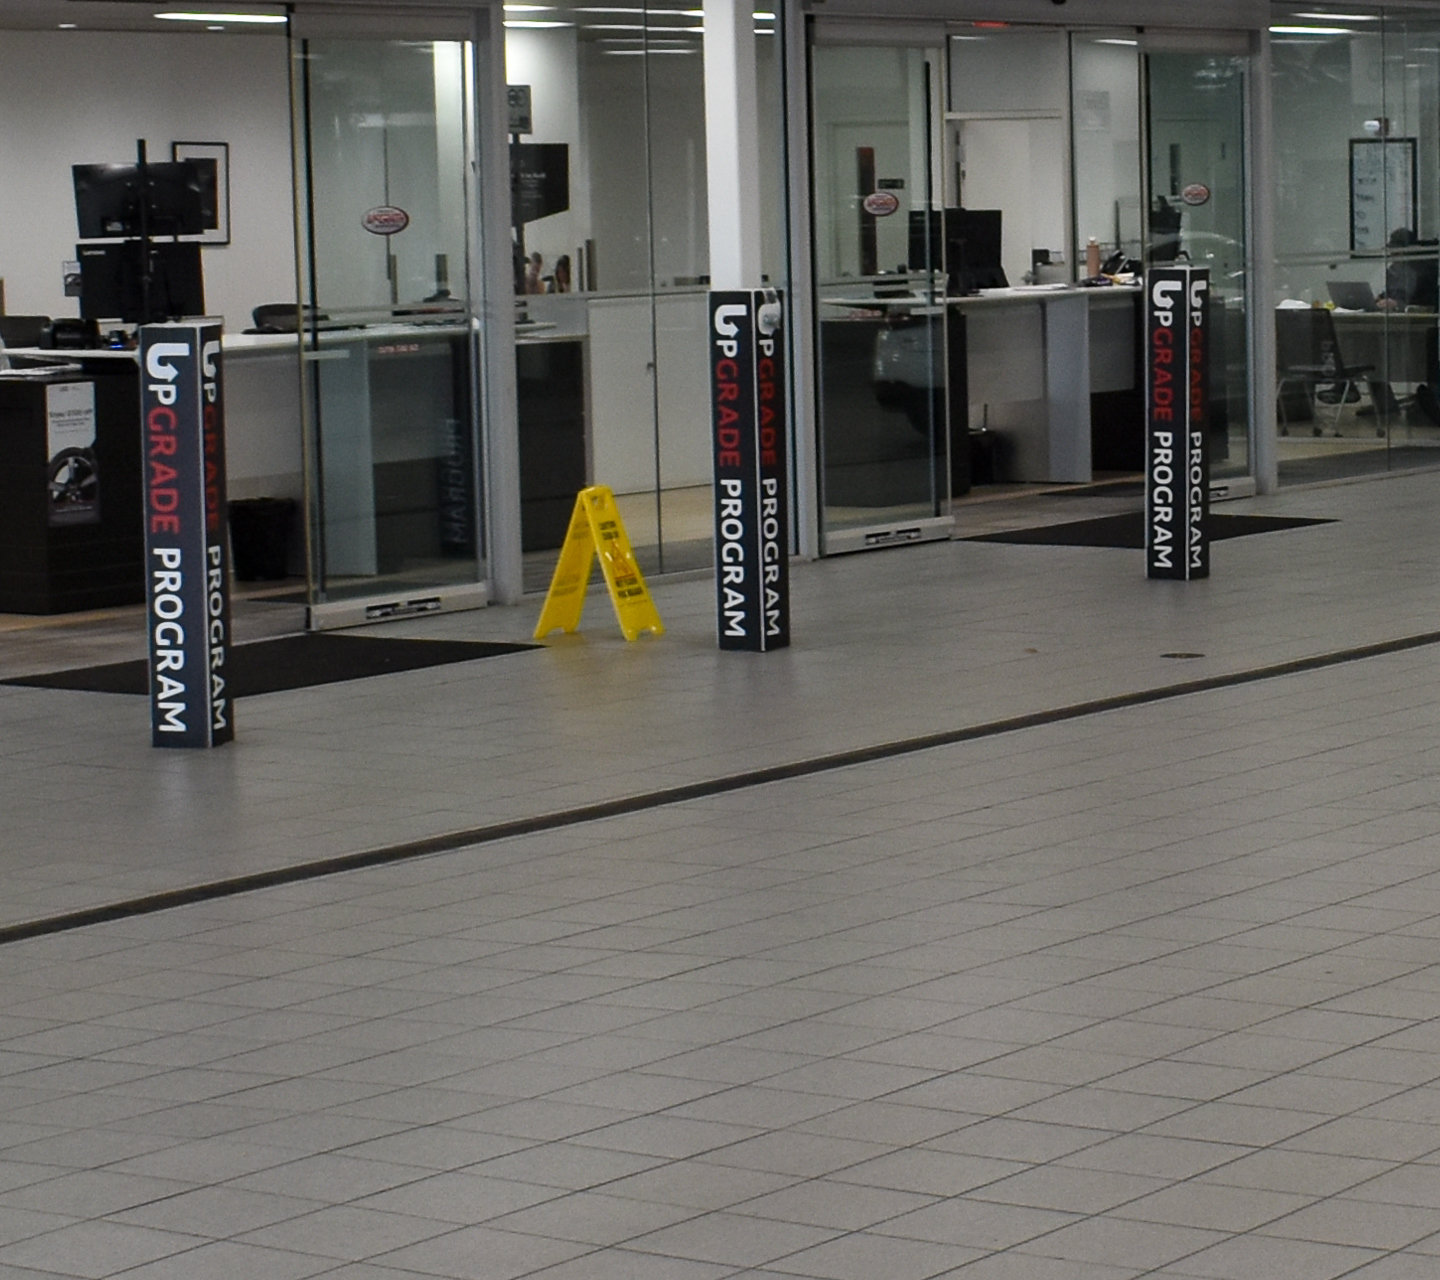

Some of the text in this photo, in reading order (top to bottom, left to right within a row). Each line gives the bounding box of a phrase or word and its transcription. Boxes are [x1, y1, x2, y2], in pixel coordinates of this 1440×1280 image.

[146, 343, 190, 733] UPGRADE PROGRAM
[713, 304, 747, 638] UPGRADE PROGRAM
[761, 478, 780, 637] PROGRAM
[1153, 280, 1182, 569] UPGRADE PROGRAM
[1190, 280, 1207, 569] UPGRADE PROGRAM
[208, 546, 227, 730] PROGRAM
